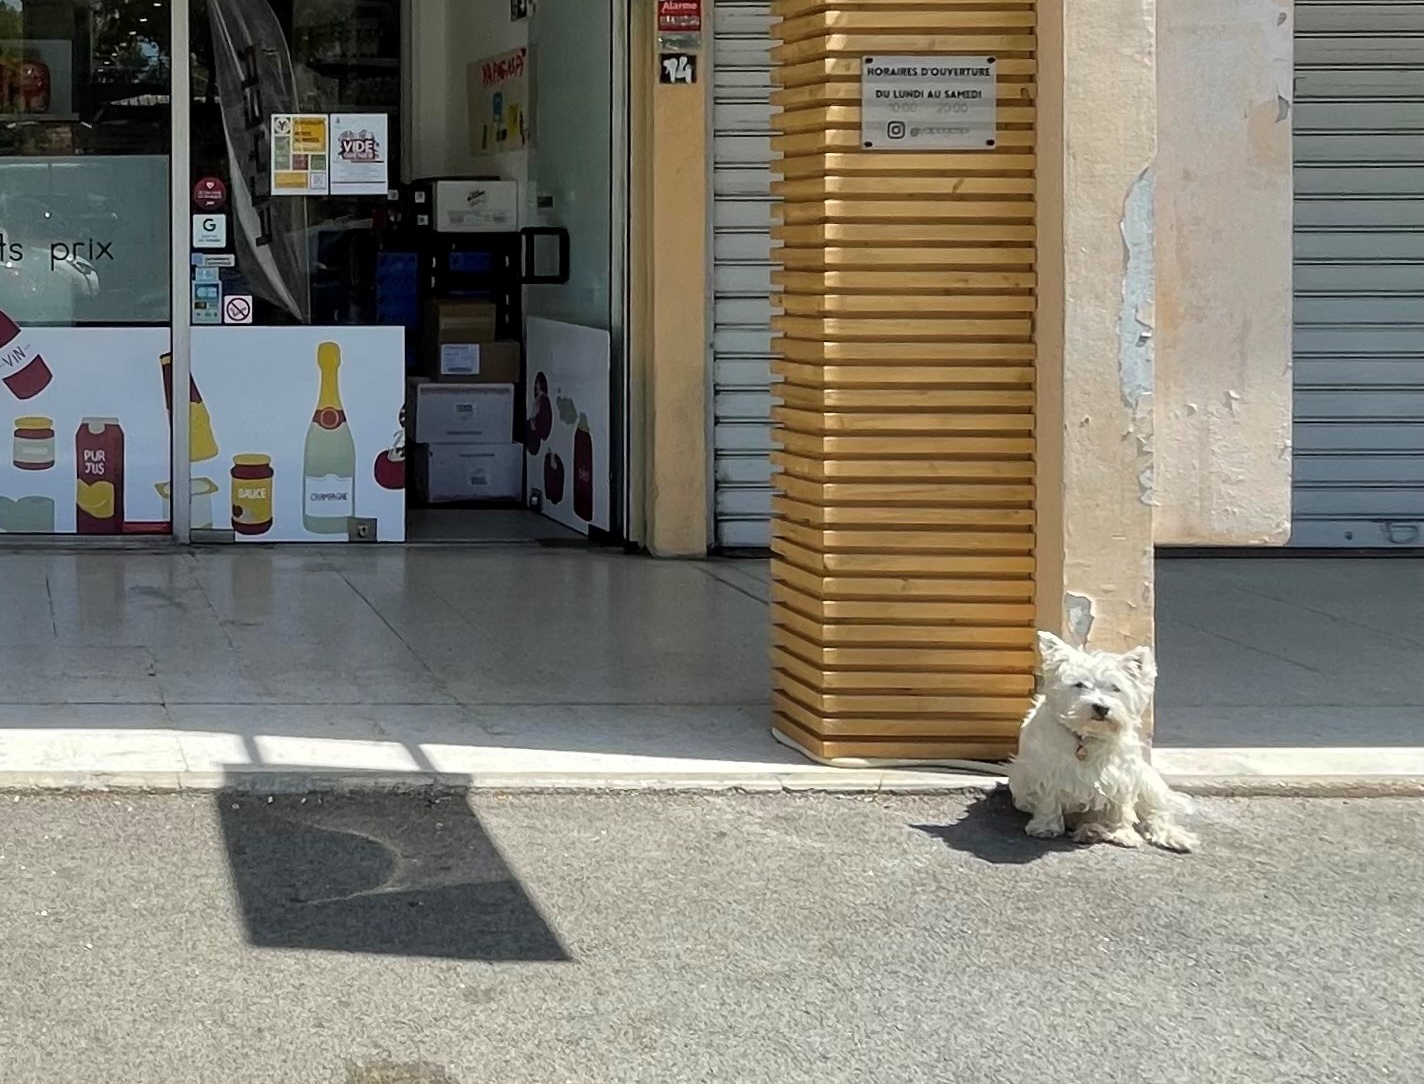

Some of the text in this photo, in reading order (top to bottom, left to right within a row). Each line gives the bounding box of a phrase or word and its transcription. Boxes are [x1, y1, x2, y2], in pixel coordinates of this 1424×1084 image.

[661, 1, 698, 14] Alarme
[662, 56, 693, 84] 14
[866, 67, 991, 77] HORAIRES D'OUVERTURE
[875, 89, 983, 99] DU LUNDI AU SAMEDI
[342, 140, 374, 153] VIDE
[202, 218, 217, 232] G
[49, 238, 114, 273] prix
[1, 345, 26, 367] VIN
[83, 449, 106, 462] PUR
[84, 462, 105, 475] JUS
